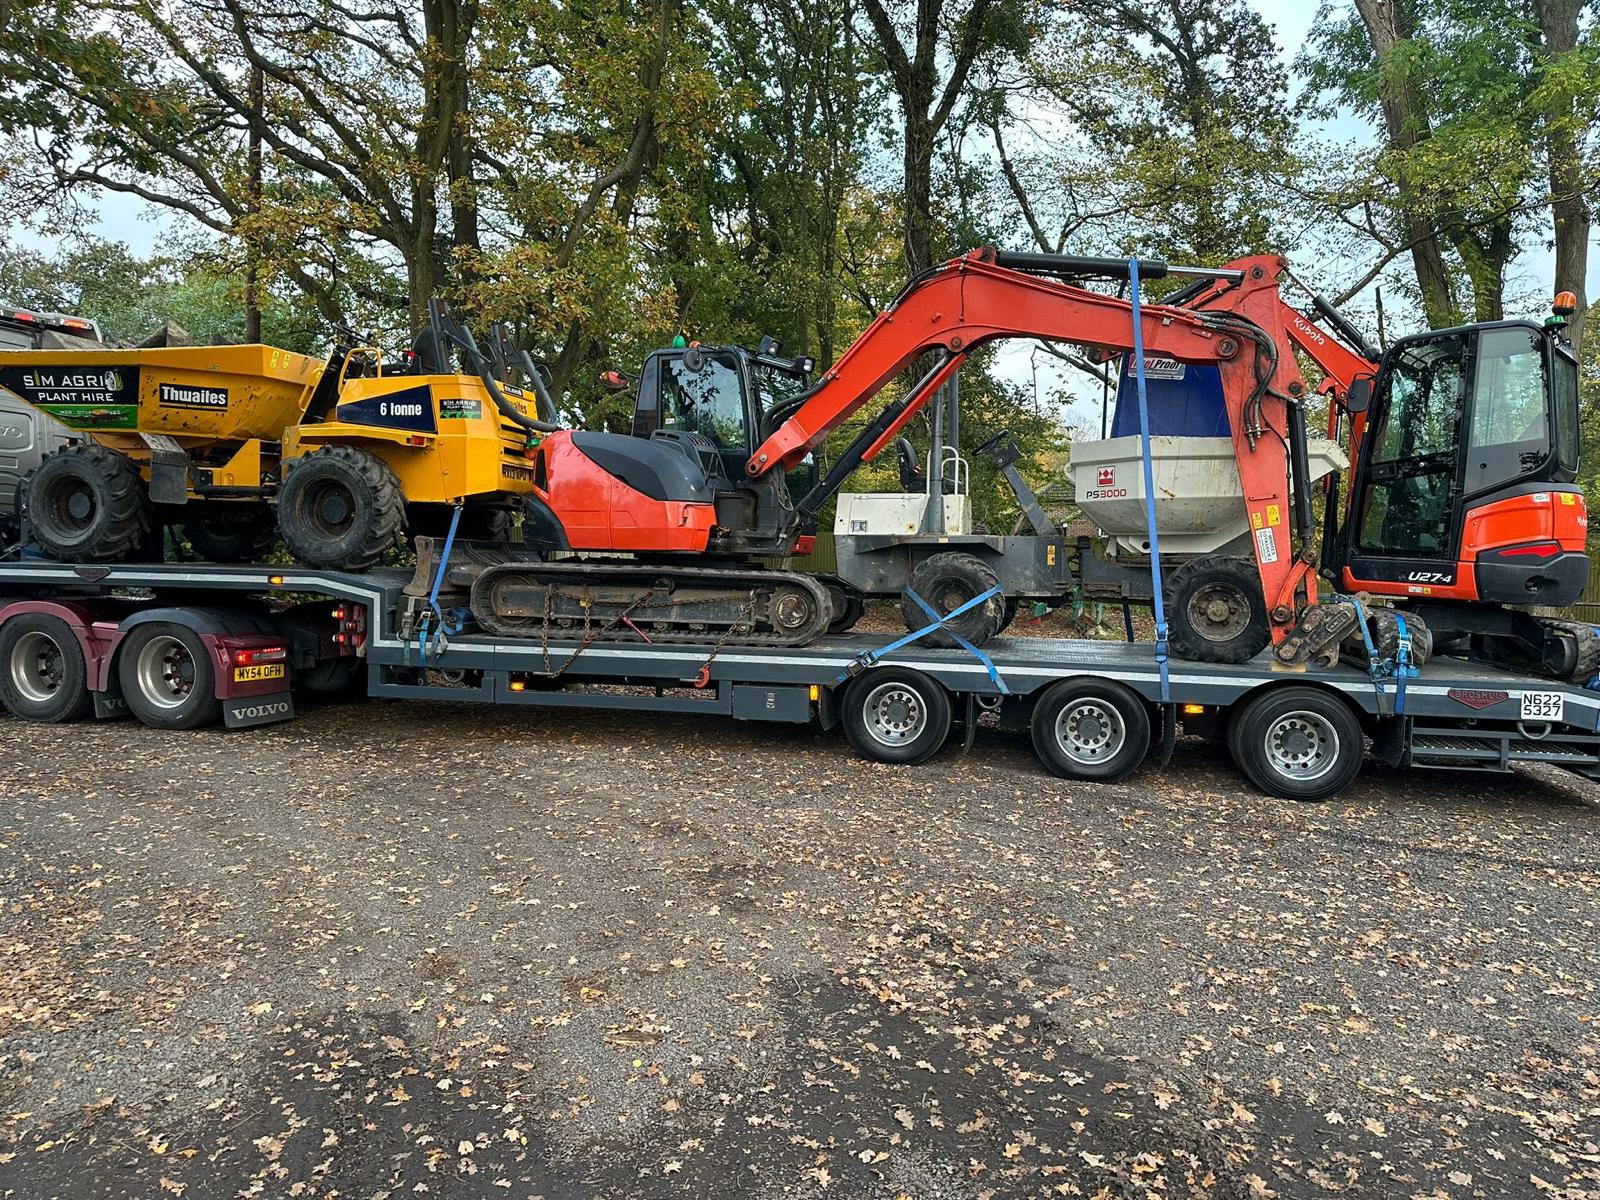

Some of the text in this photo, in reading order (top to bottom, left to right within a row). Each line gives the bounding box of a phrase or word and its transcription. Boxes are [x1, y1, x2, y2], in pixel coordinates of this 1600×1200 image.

[1293, 316, 1325, 345] Kubota
[62, 375, 103, 387] AGRI
[38, 392, 114, 402] PLANT HIRE
[161, 386, 227, 405] Thwaites
[380, 402, 422, 416] 6 tonne
[1086, 489, 1127, 499] PS3000
[1408, 571, 1453, 583] U27-4
[239, 665, 282, 679] MY54 OFH
[1455, 690, 1505, 700] BROSHUIS
[1523, 693, 1562, 706] N622
[232, 702, 289, 720] VOLVO
[1523, 704, 1561, 717] 5327
